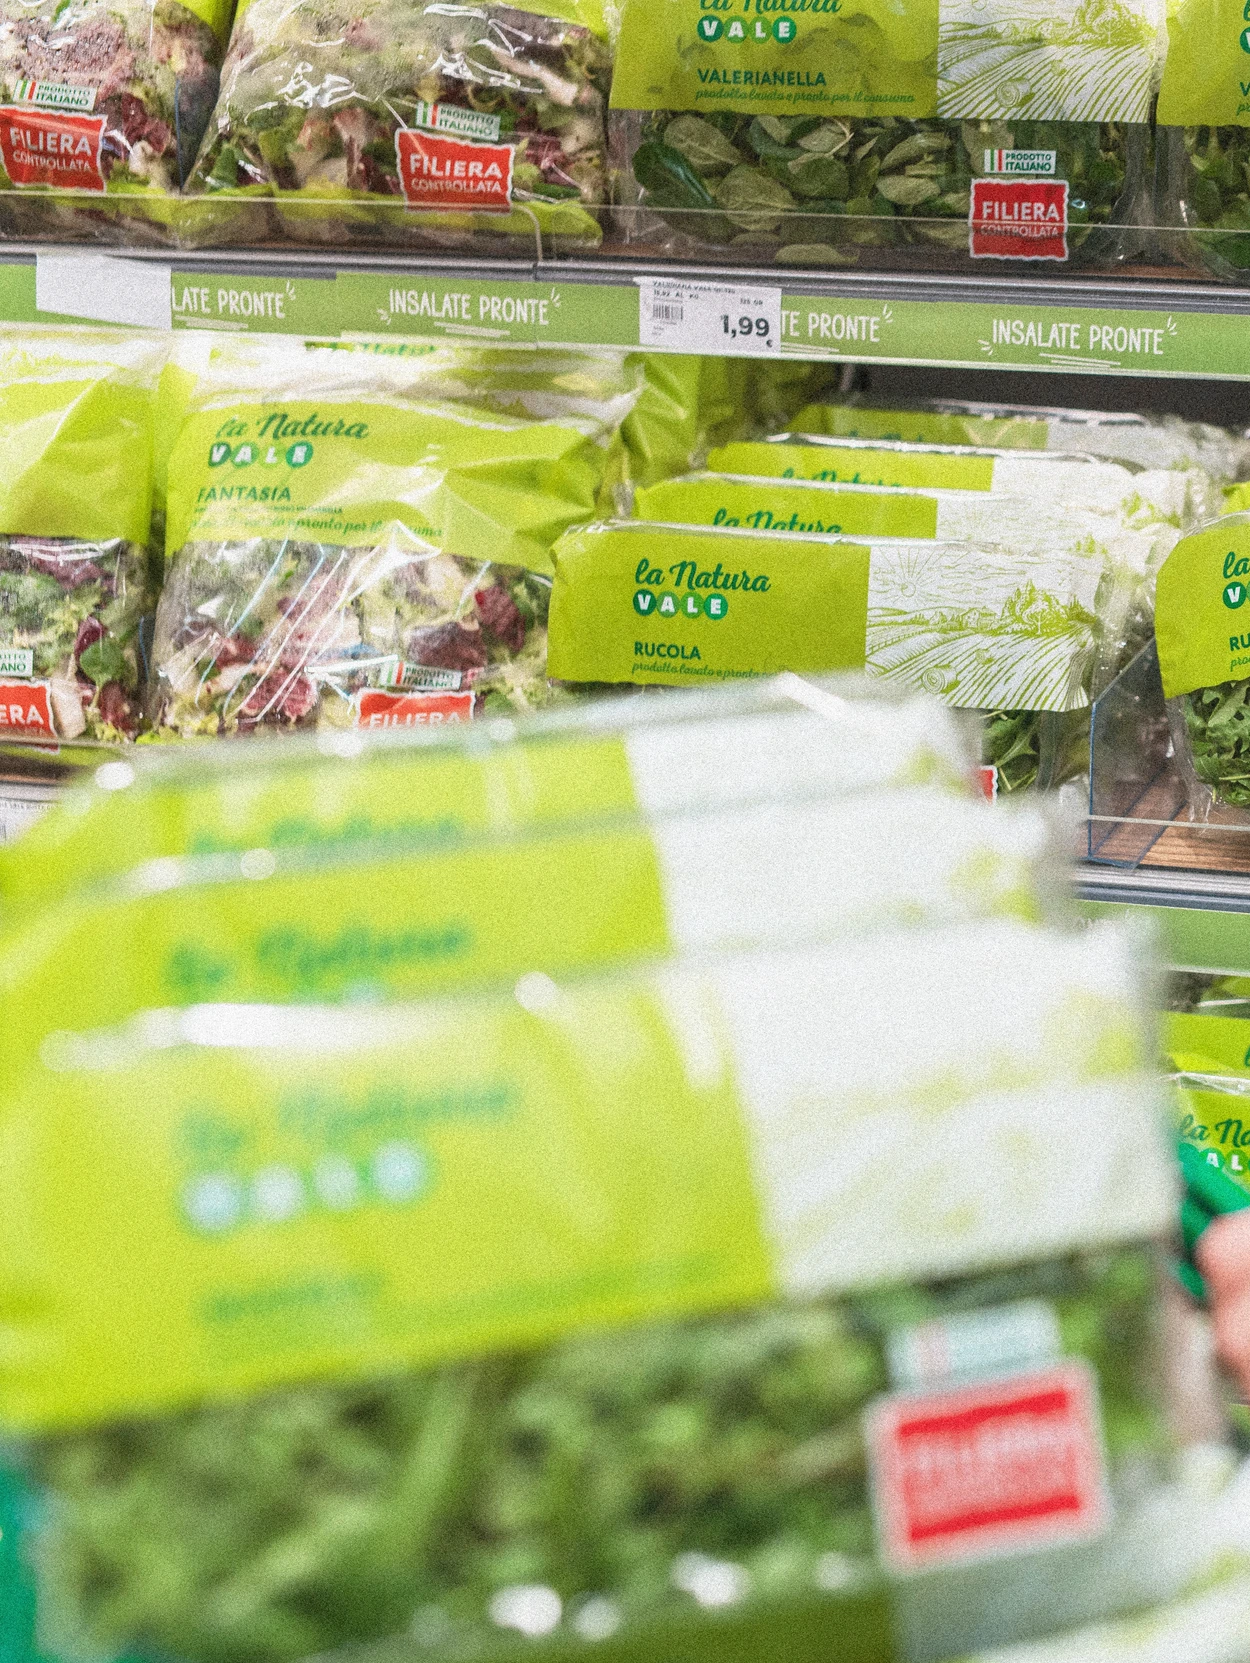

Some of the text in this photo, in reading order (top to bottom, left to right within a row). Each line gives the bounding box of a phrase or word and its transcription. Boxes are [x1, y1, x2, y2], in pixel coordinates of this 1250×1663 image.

[700, 18, 793, 40] VALE
[697, 68, 827, 87] VALERIANELLA
[36, 93, 90, 107] ITALIANO
[439, 118, 493, 137] ITALIANO
[440, 107, 494, 126] PRODOTTO
[9, 127, 92, 156] FILIERA
[13, 151, 92, 173] CONTROLLATA
[409, 153, 503, 179] FILIERA
[1005, 153, 1052, 161] PRODOTTO
[1005, 162, 1052, 172] ITALIANO
[411, 178, 503, 194] CONTROLLATA
[982, 201, 1060, 222] FILIERA
[981, 224, 1060, 238] CONTROLLATA
[171, 286, 286, 319] LATE PRONTE
[389, 288, 550, 326] INSALATE PRONTE
[720, 314, 771, 339] 1,99
[807, 312, 881, 343] PRONTE
[992, 318, 1165, 355] INSALATE PRONTE
[255, 412, 369, 441] Natura
[197, 486, 292, 503] FANTASIA
[747, 511, 843, 534] Natura
[635, 558, 772, 593] la Natura
[636, 592, 724, 616] VALE
[634, 641, 702, 661] RUCOLA
[632, 661, 678, 675] prodotto
[1180, 1114, 1211, 1141] la
